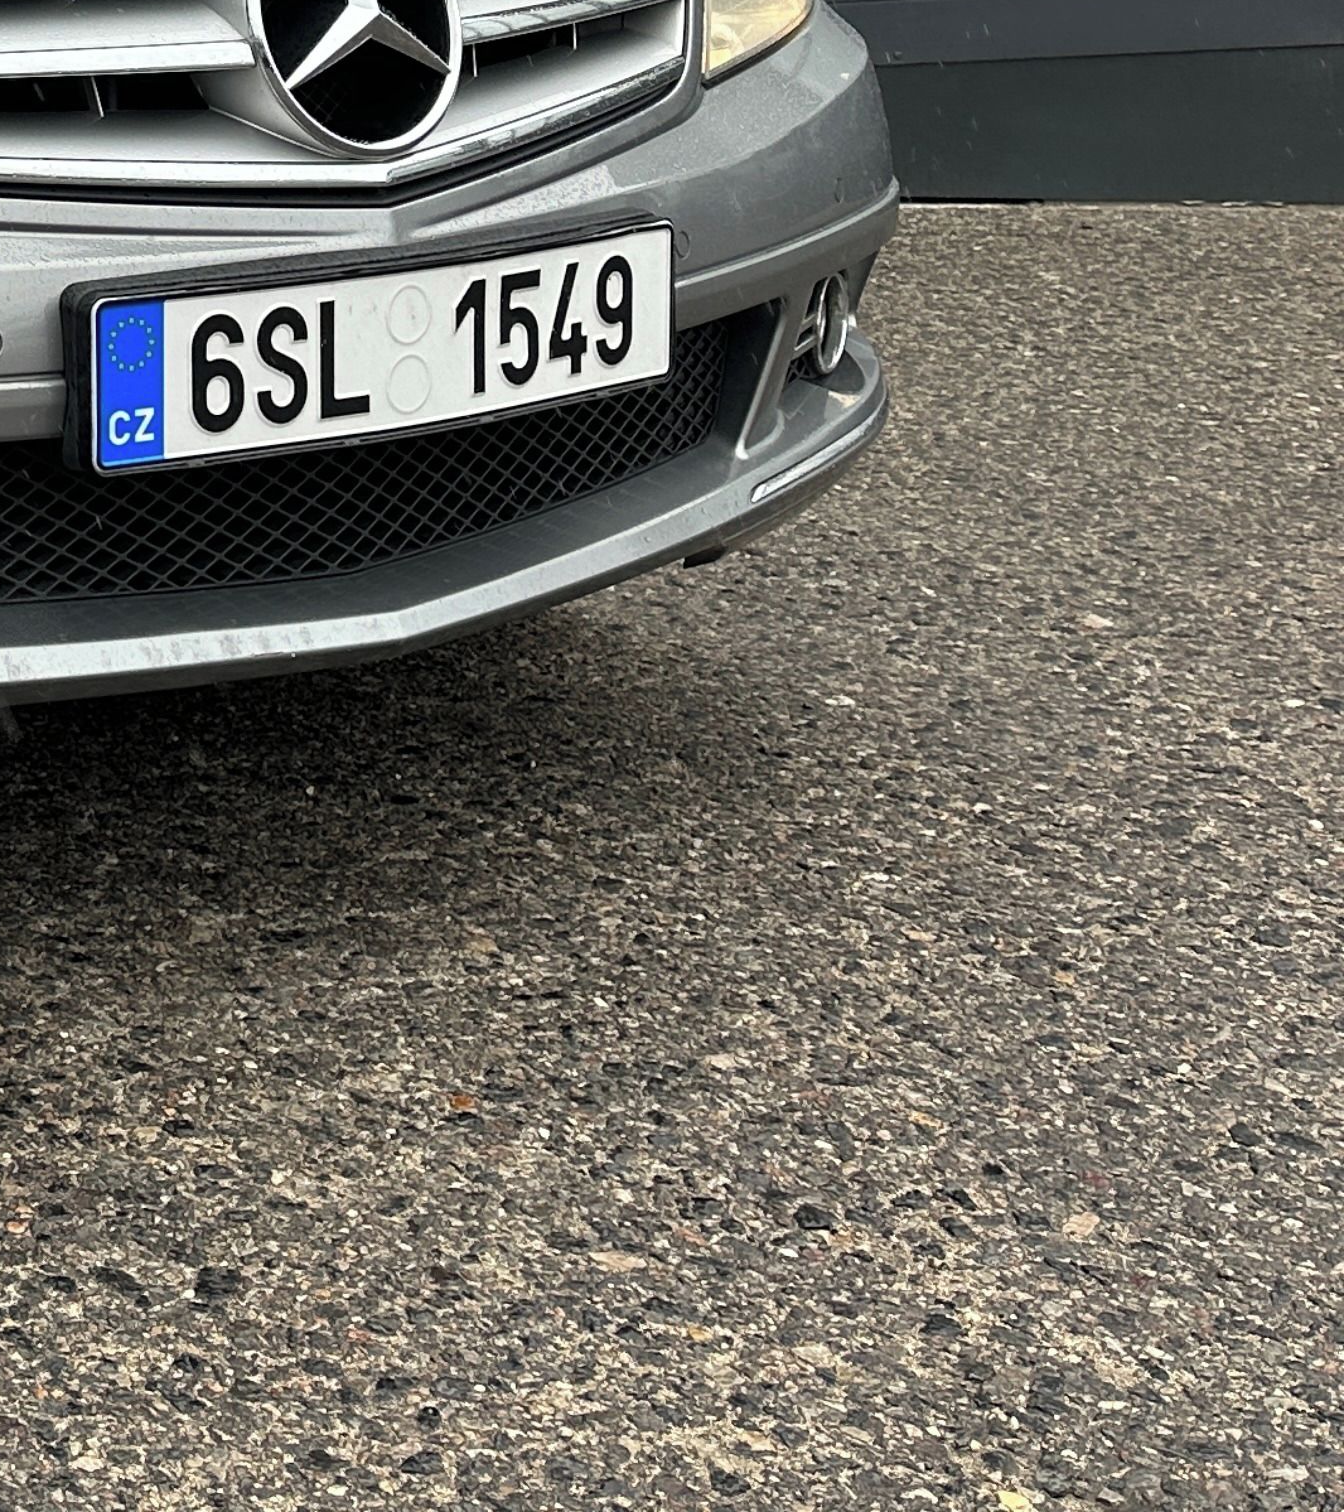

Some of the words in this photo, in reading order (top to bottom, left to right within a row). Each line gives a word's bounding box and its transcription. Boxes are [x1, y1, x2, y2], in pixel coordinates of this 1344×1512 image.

[192, 300, 370, 433] 6SL
[455, 255, 633, 394] 1549
[108, 407, 155, 445] CZ
